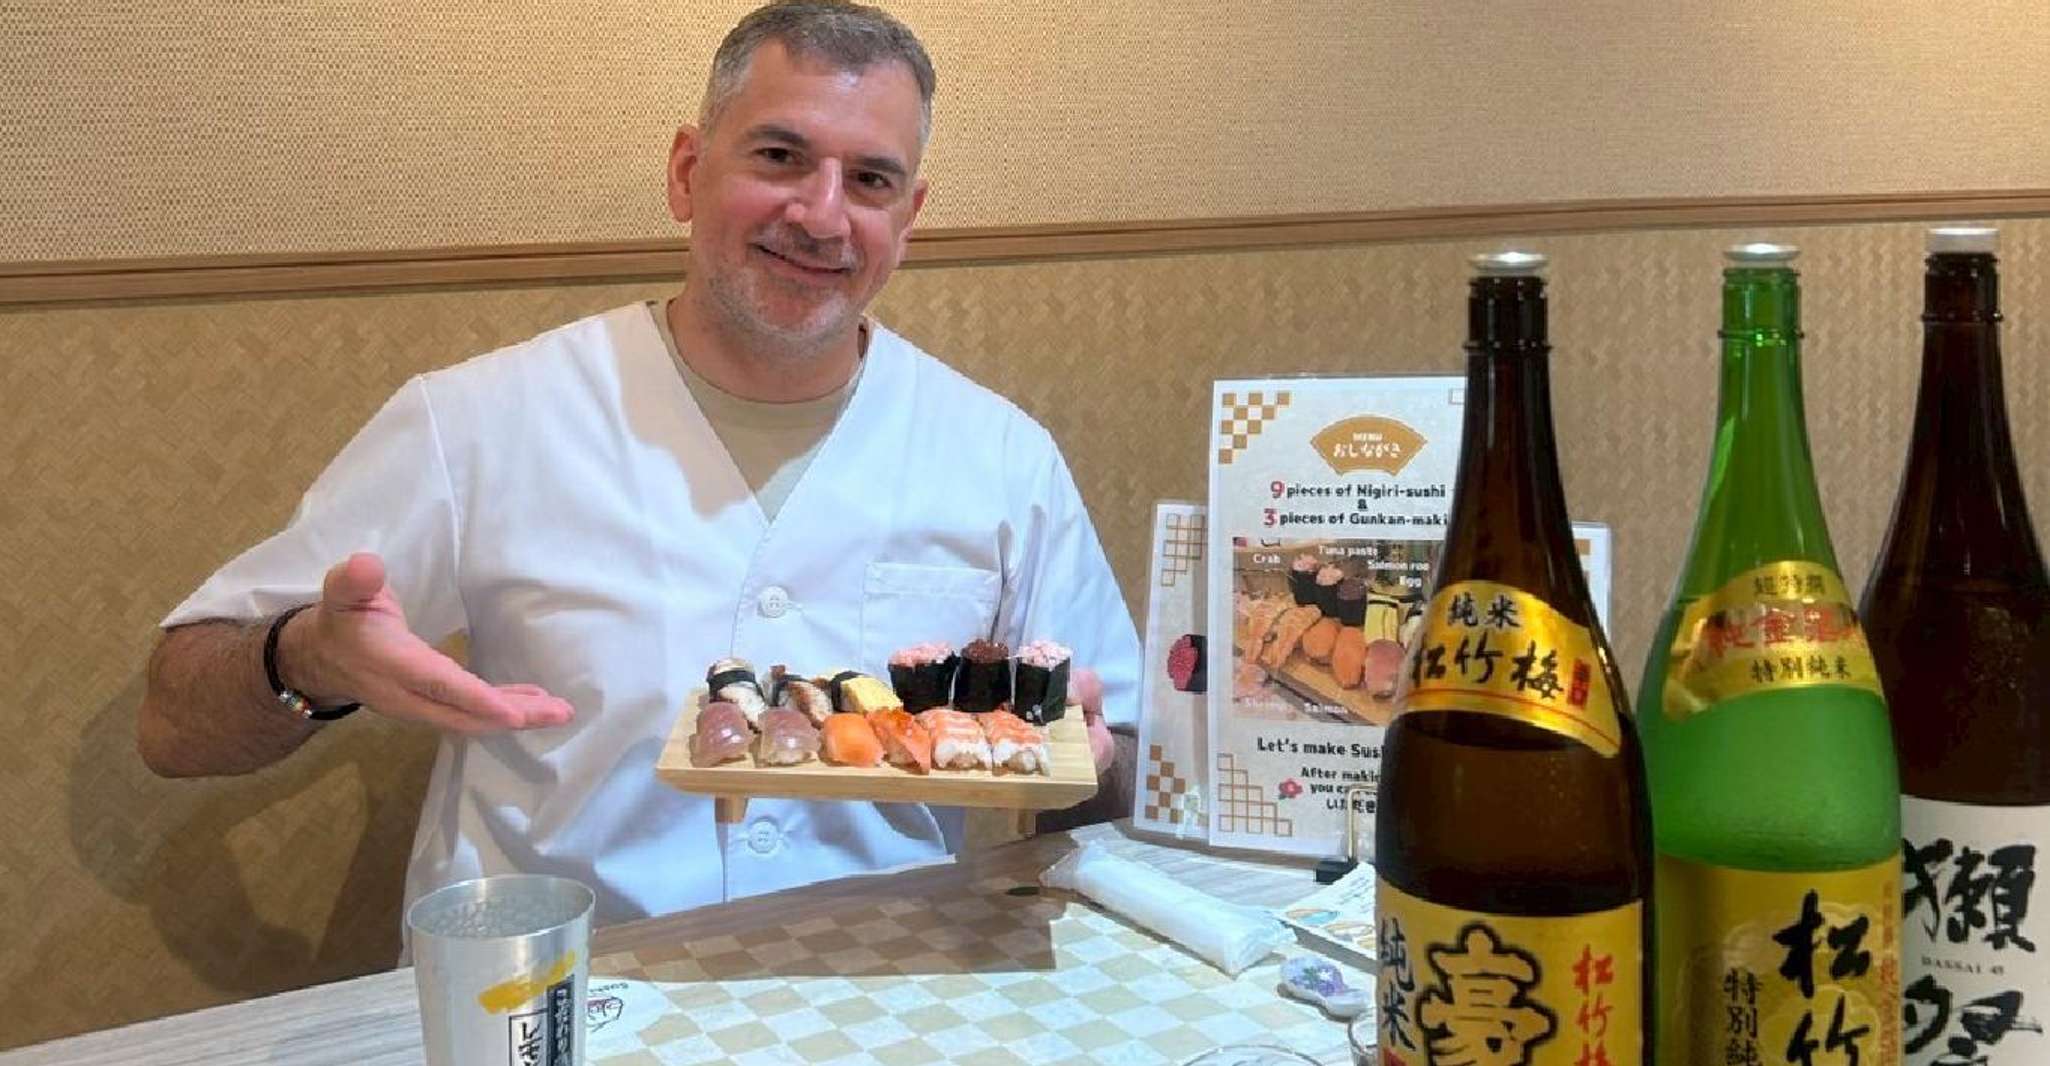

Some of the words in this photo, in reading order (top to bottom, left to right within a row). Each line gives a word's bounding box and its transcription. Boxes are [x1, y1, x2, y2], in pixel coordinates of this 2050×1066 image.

[1352, 432, 1382, 442] MENU
[1333, 443, 1400, 458] おしながき
[1270, 481, 1285, 499] 9
[1286, 483, 1331, 498] pieces
[1335, 485, 1351, 497] of
[1356, 484, 1446, 499] Nigiri-sushi
[1357, 499, 1368, 511] &
[1263, 508, 1277, 527] 3
[1280, 513, 1324, 526] pieces
[1328, 513, 1345, 525] of
[1349, 513, 1448, 526] Gunkan-maki
[1318, 545, 1345, 556] Tuna
[1252, 553, 1281, 564] Crab
[1367, 560, 1407, 571] Salmon
[1399, 575, 1422, 587] Egg
[1447, 590, 1521, 629] 純米
[1411, 631, 1564, 699] 松竹梅
[1750, 655, 1851, 684] 特別純米
[1256, 736, 1299, 753] Let's
[1303, 743, 1345, 756] make
[1301, 766, 1337, 780] After
[1310, 783, 1334, 795] you
[517, 1020, 545, 1066] レモ
